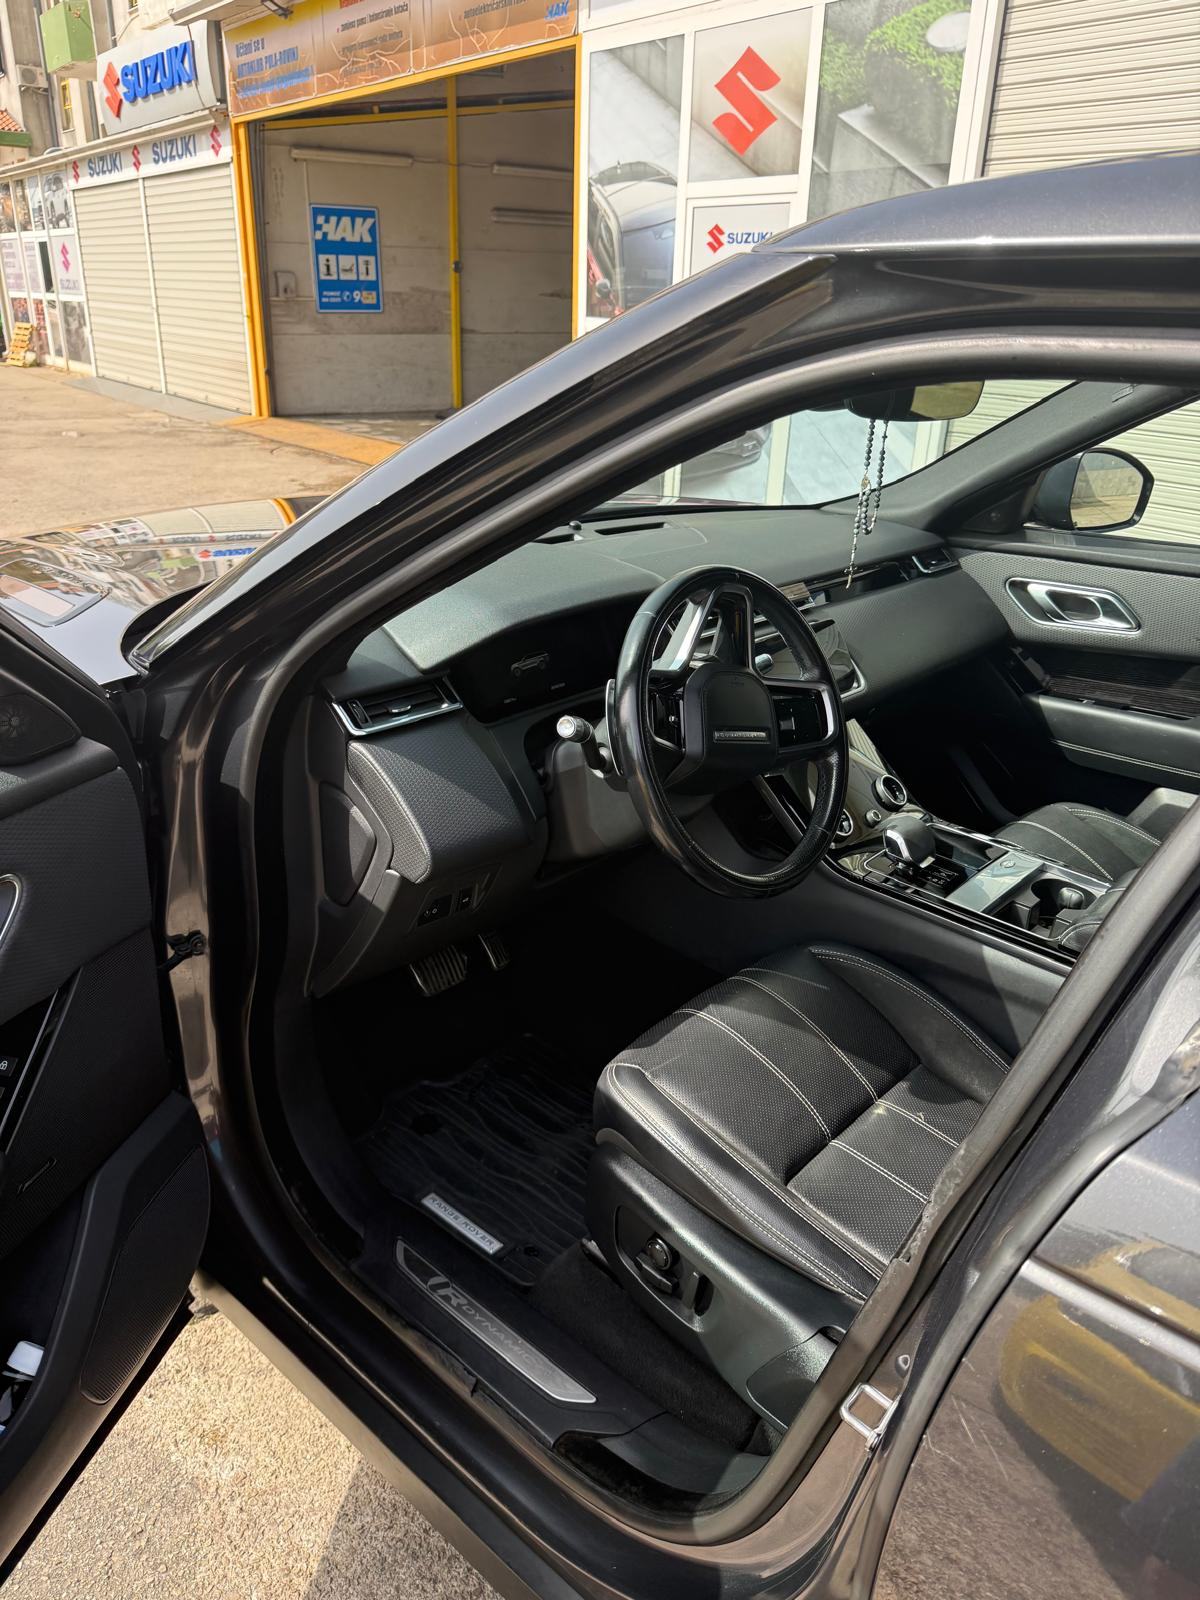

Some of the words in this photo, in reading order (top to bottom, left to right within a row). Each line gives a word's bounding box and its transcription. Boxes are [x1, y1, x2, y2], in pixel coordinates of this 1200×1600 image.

[121, 40, 194, 103] SUZUKI
[87, 152, 122, 177] SUZUKI
[152, 134, 197, 165] SUZUKI
[315, 215, 375, 243] HAK
[429, 1196, 461, 1221] RANGE
[462, 1221, 495, 1246] ROVER
